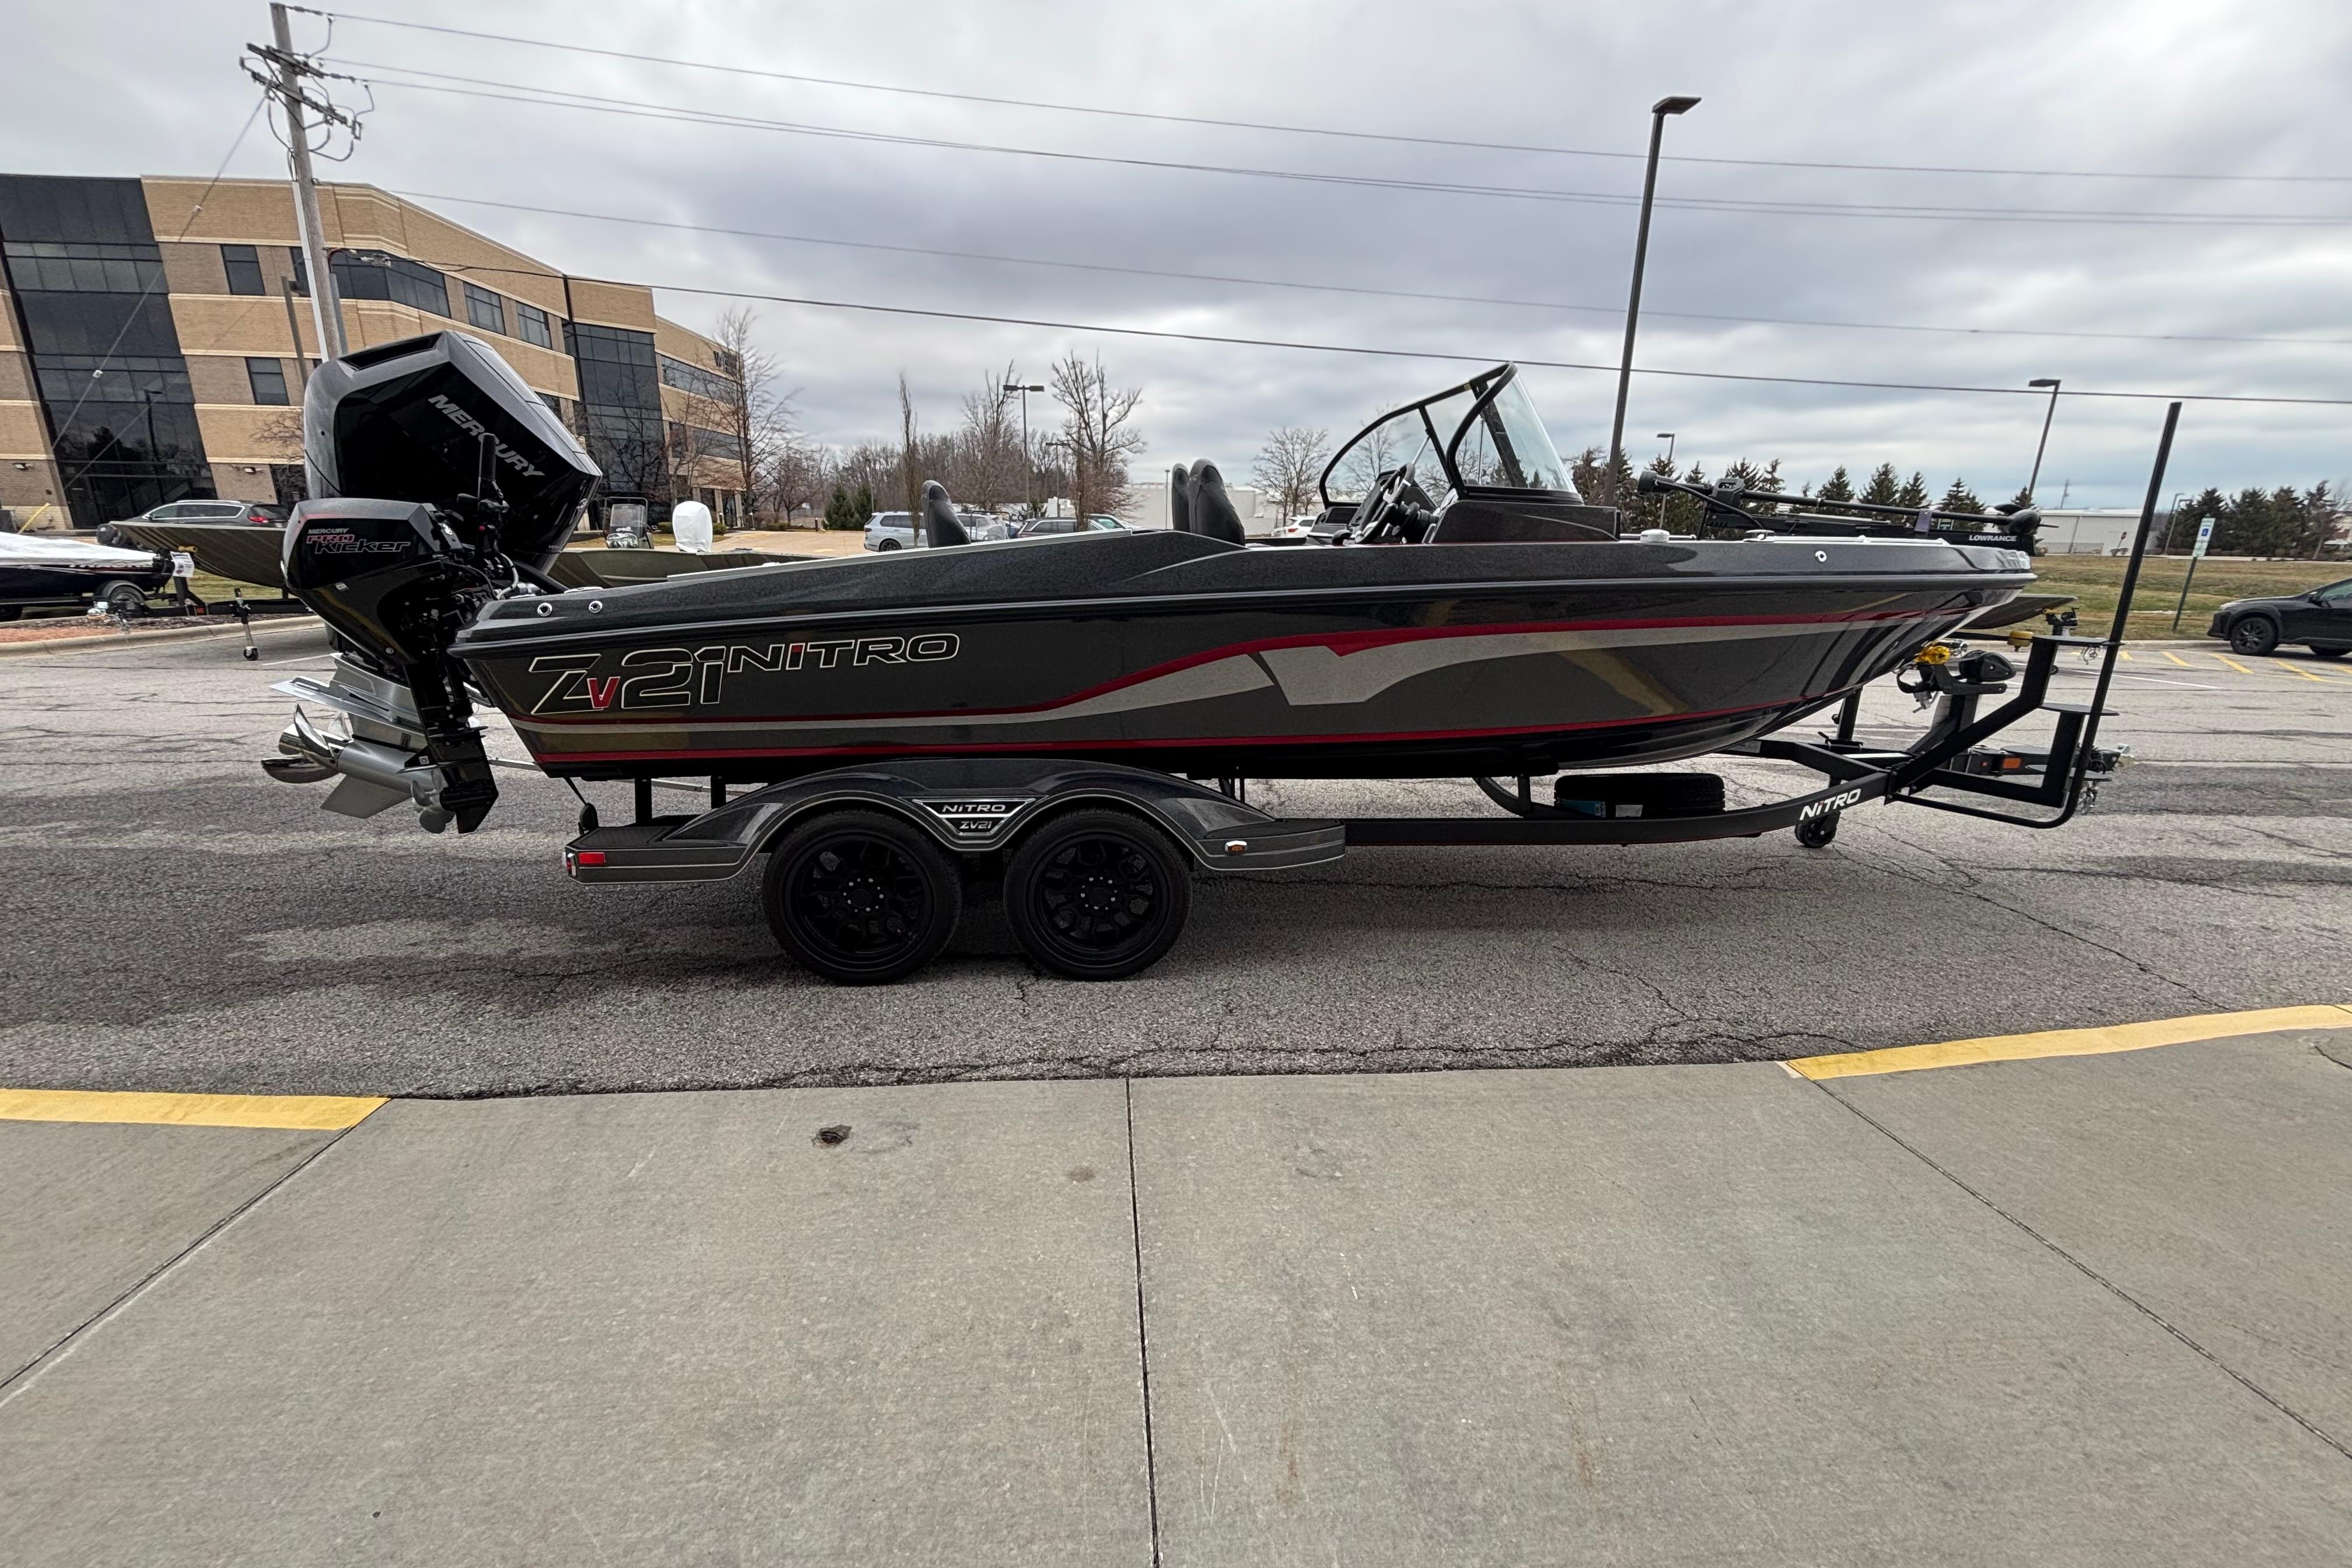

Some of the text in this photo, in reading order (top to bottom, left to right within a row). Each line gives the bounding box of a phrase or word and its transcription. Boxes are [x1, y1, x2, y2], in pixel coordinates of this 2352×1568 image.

[306, 534, 355, 544] PRO
[727, 634, 960, 673] NITRO
[942, 804, 1006, 813] NITRO
[1799, 788, 1861, 821] NITRO
[960, 821, 993, 829] ZV21
